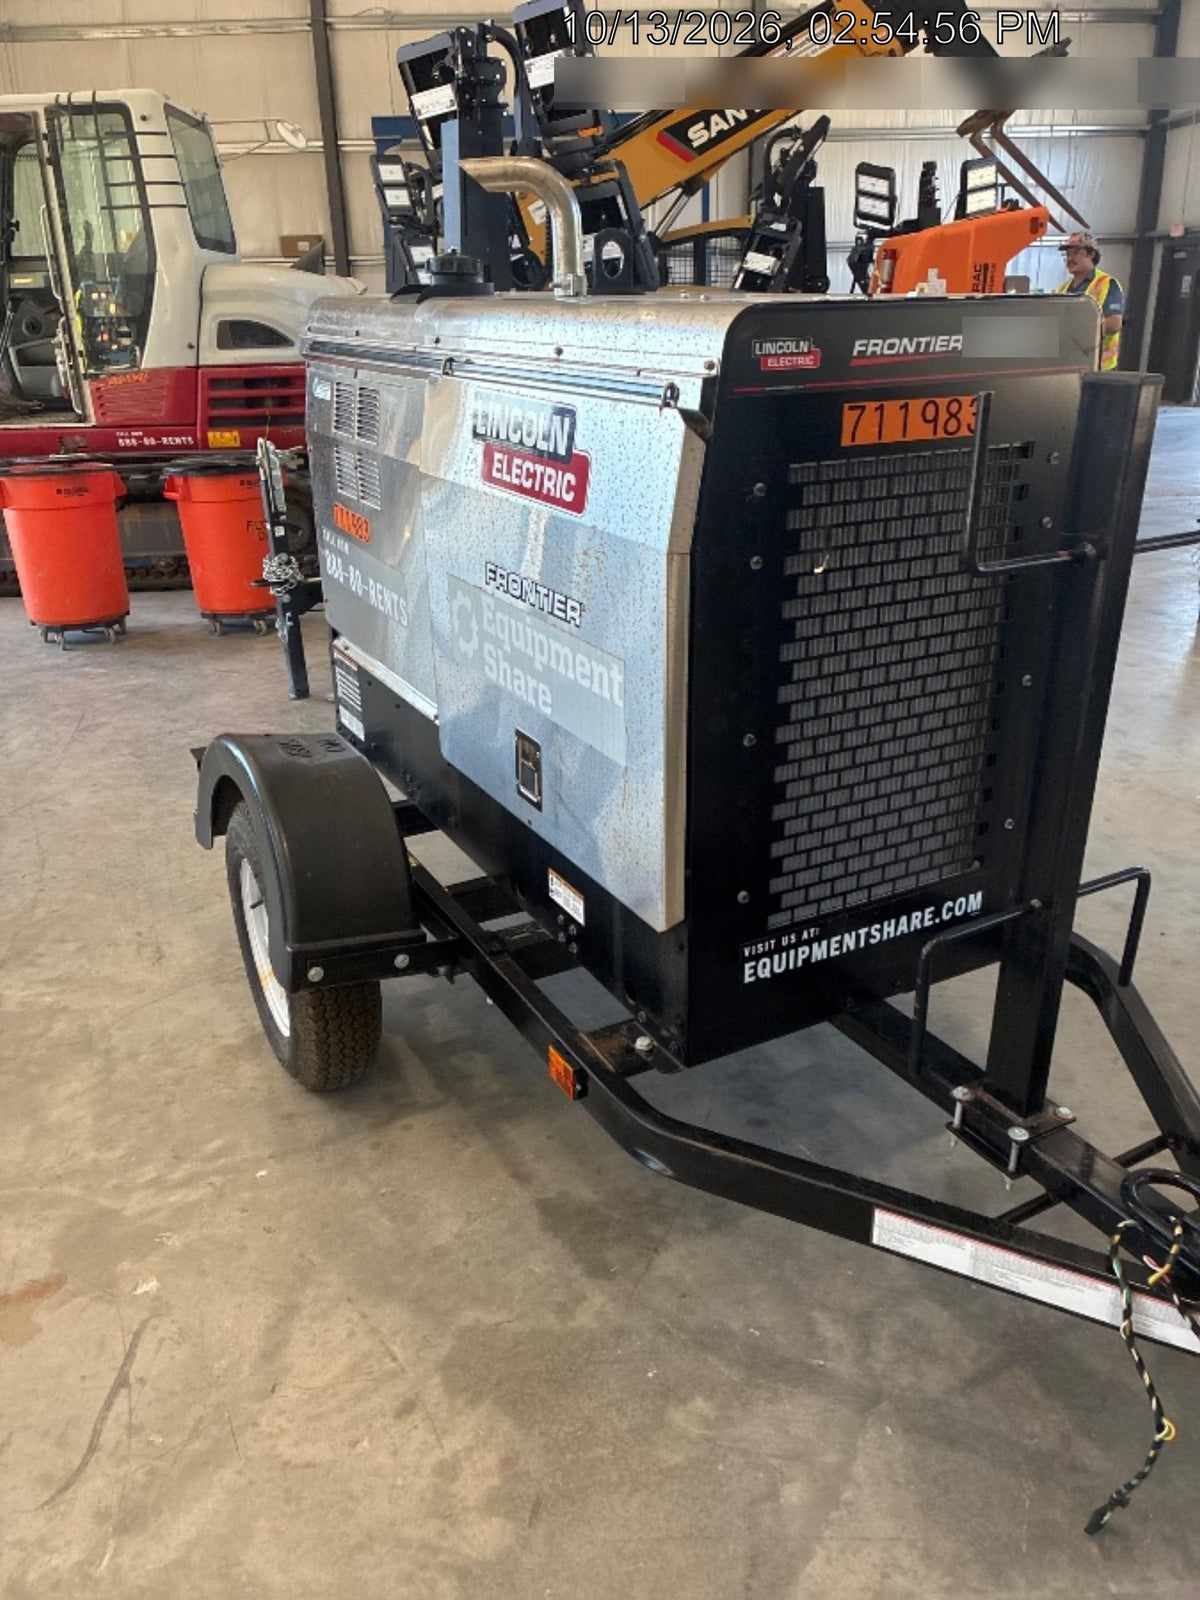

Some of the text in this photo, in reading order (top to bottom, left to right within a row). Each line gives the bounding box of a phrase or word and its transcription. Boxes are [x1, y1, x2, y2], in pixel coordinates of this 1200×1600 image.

[687, 109, 761, 148] SAN
[754, 340, 810, 355] LINCOLN
[767, 355, 815, 367] ELECTRIC
[852, 334, 963, 356] FRONTIER
[474, 398, 571, 456] LINCOLN
[491, 452, 577, 502] ELECTRIC
[484, 561, 584, 628] FRONTIER
[480, 595, 624, 708] Equipment
[483, 640, 552, 715] Share
[743, 891, 983, 983] EQUIPMENTSHARE.COM
[743, 938, 776, 957] VISIT
[781, 933, 797, 947] US
